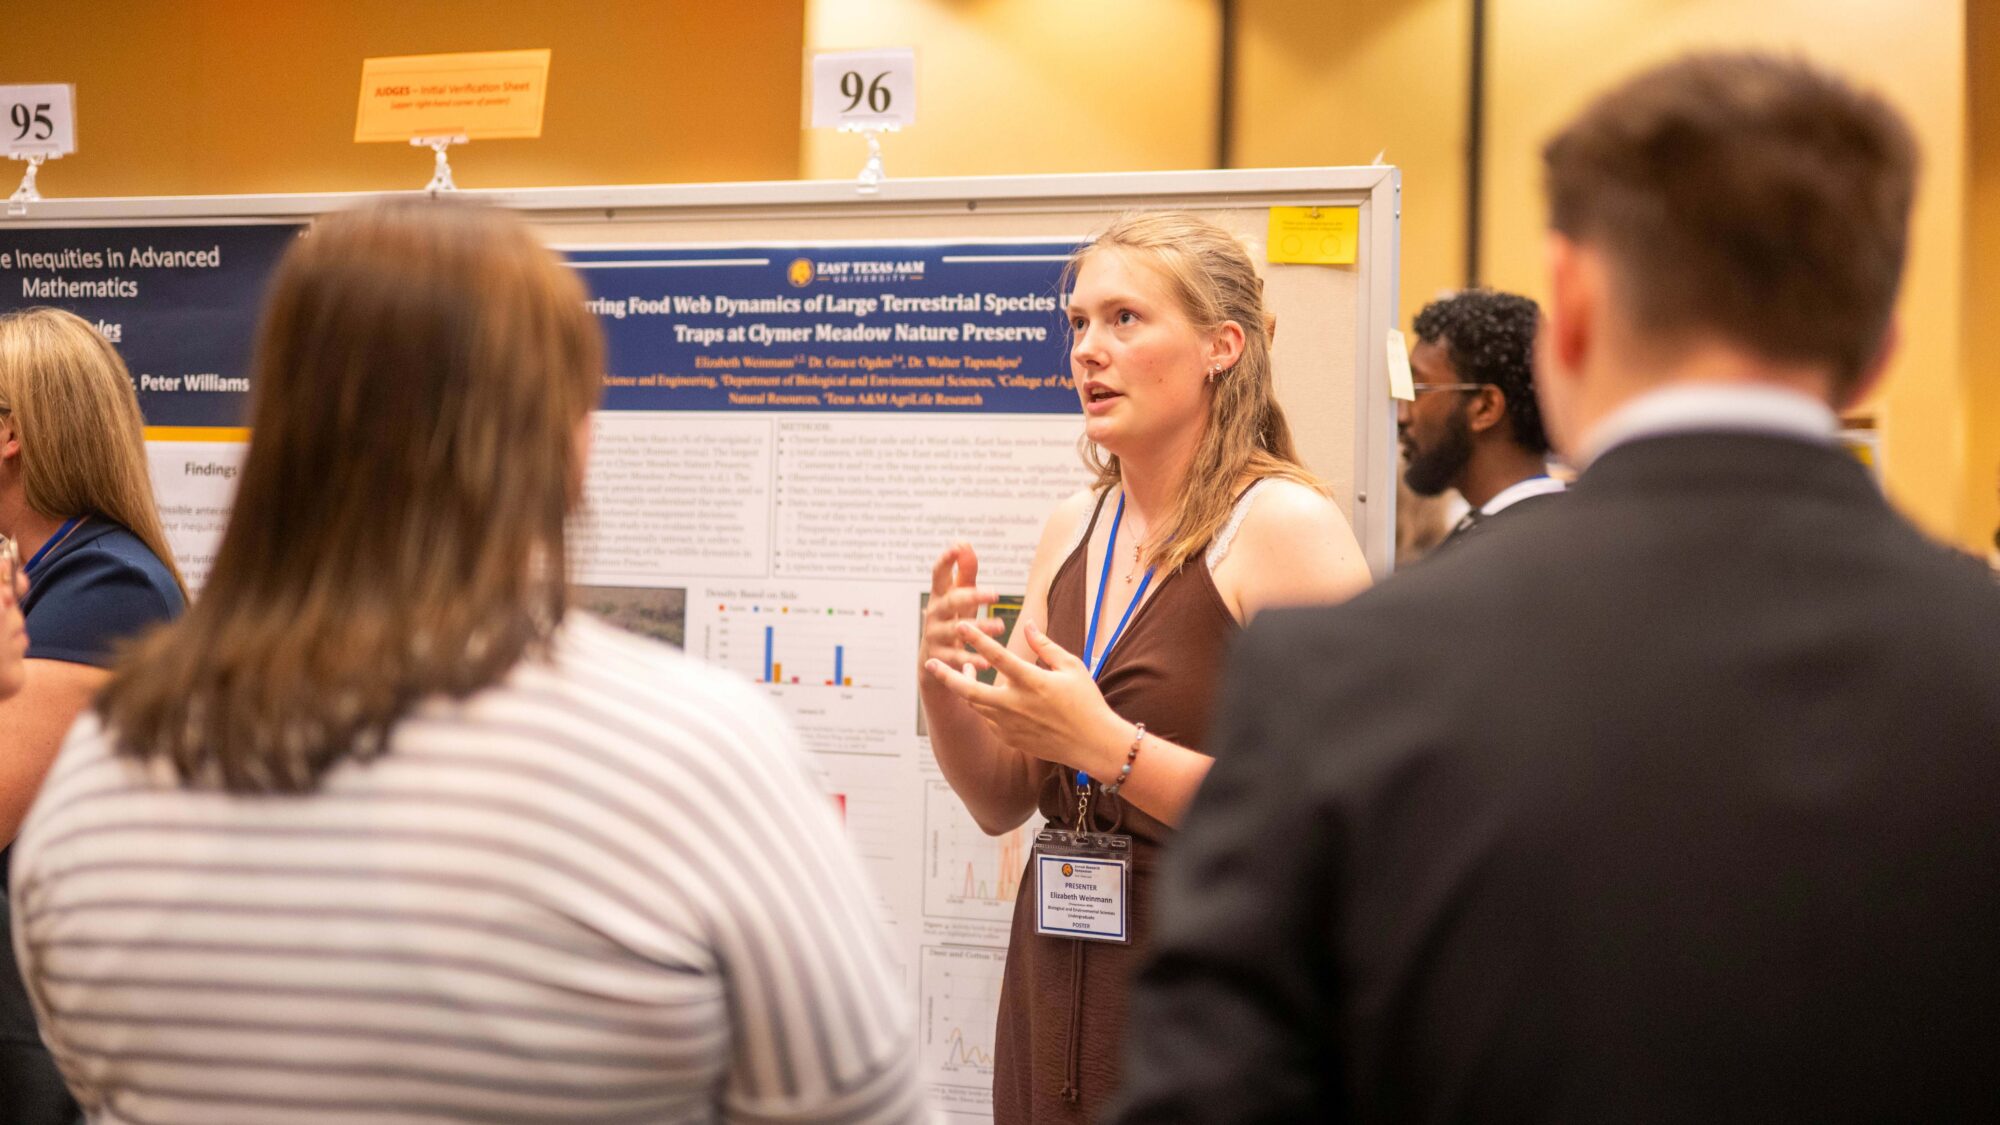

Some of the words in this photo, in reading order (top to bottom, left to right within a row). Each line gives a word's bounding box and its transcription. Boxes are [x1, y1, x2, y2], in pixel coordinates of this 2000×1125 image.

[375, 86, 410, 98] JUDGES
[420, 85, 446, 95] Initial
[449, 83, 499, 95] Verification
[504, 82, 530, 92] Sheet
[840, 71, 892, 113] 96
[11, 103, 53, 141] 95
[0, 255, 12, 269] e
[16, 248, 103, 272] Inequities
[107, 247, 124, 268] in
[129, 245, 220, 268] Advanced
[817, 262, 850, 274] EAST
[853, 261, 894, 274] TEXAS
[895, 261, 925, 274] A&M
[22, 276, 139, 298] Mathematics
[833, 275, 907, 283] UNIVERSITY
[628, 296, 670, 314] Food
[673, 296, 712, 314] Web
[715, 294, 801, 318] Dynamics
[804, 294, 823, 312] of
[826, 294, 877, 316] Large
[880, 292, 981, 312] Terrestrial
[984, 292, 1056, 316] Species
[674, 324, 724, 346] Traps
[727, 325, 746, 342] at
[748, 323, 813, 346] Clymer
[815, 323, 892, 342] Meadow
[895, 323, 959, 342] Nature
[962, 322, 1047, 342] Preserve
[695, 356, 741, 368] Elizabeth
[141, 374, 181, 391] Peter
[184, 373, 250, 392] Williams
[849, 374, 867, 386] and
[184, 462, 238, 479] Findings
[1065, 882, 1097, 891] PRESENTER
[1050, 891, 1078, 901] Elizabeth
[1079, 894, 1113, 904] Weinmann
